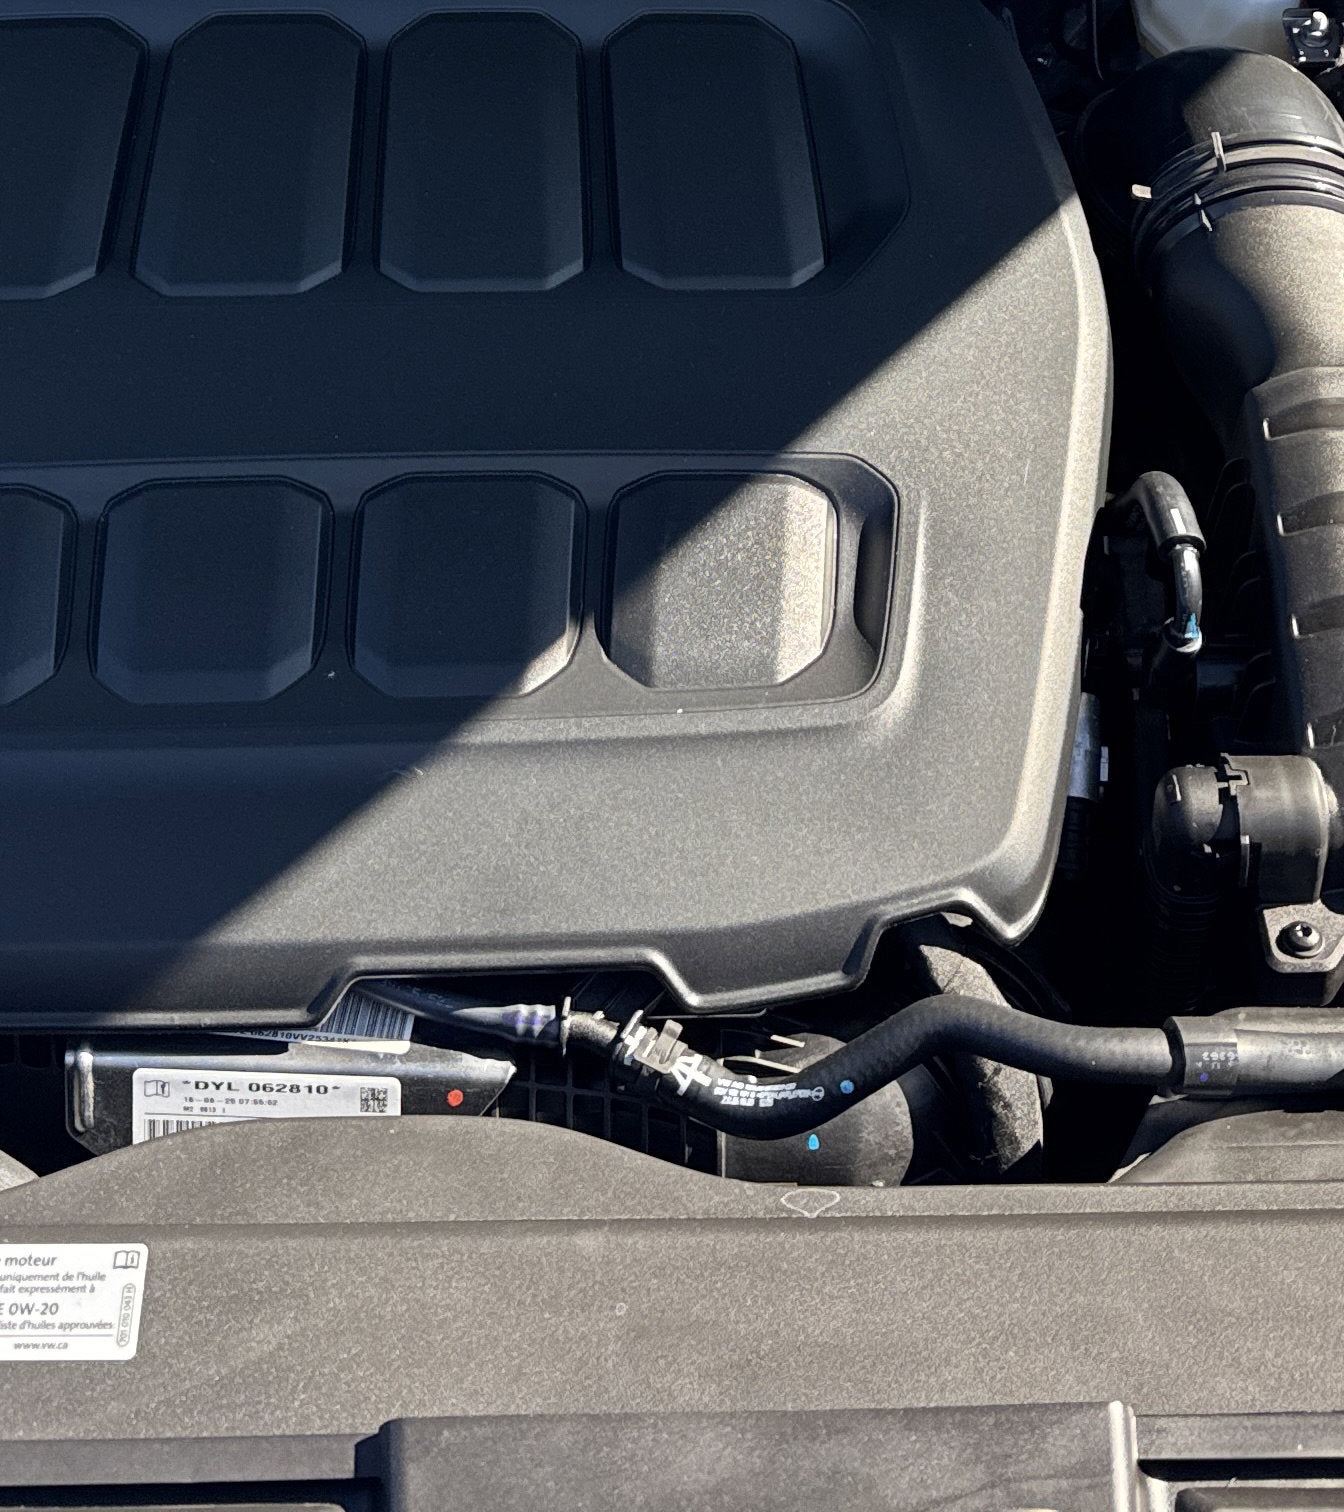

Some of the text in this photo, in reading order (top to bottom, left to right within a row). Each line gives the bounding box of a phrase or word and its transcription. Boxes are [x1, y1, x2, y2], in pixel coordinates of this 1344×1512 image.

[4, 1255, 58, 1267] moteur
[0, 1272, 60, 1283] uniquement
[62, 1272, 74, 1282] de
[76, 1272, 106, 1282] l'huile
[18, 1284, 87, 1296] expressément
[89, 1284, 96, 1293] à
[9, 1302, 59, 1315] 0W-20
[19, 1320, 56, 1330] d'huiles
[14, 1341, 68, 1350] www.vw.ca
